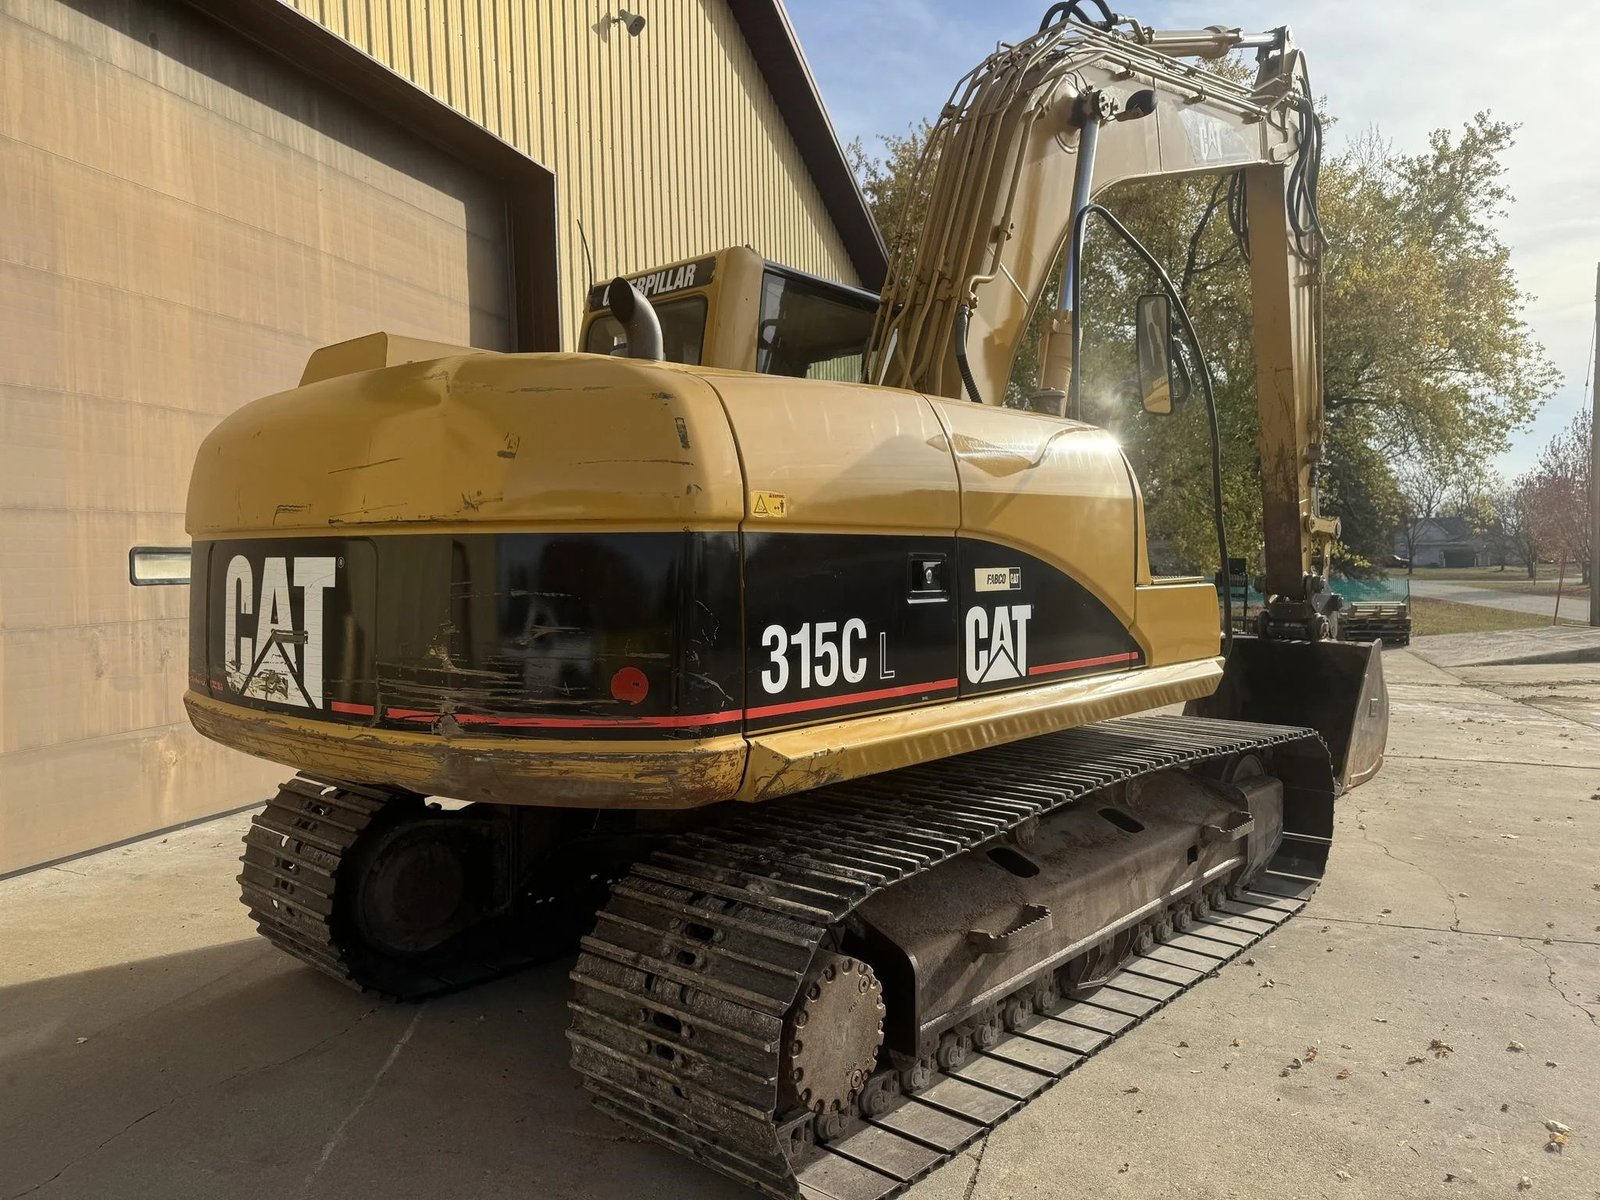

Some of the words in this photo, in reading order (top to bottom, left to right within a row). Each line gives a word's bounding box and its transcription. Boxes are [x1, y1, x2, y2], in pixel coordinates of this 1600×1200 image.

[602, 263, 697, 306] RPILLAR
[986, 573, 1007, 585] FABCO
[225, 554, 336, 710] CAT
[761, 617, 867, 694] 315C
[879, 631, 895, 680] L
[965, 604, 1032, 684] CAT
